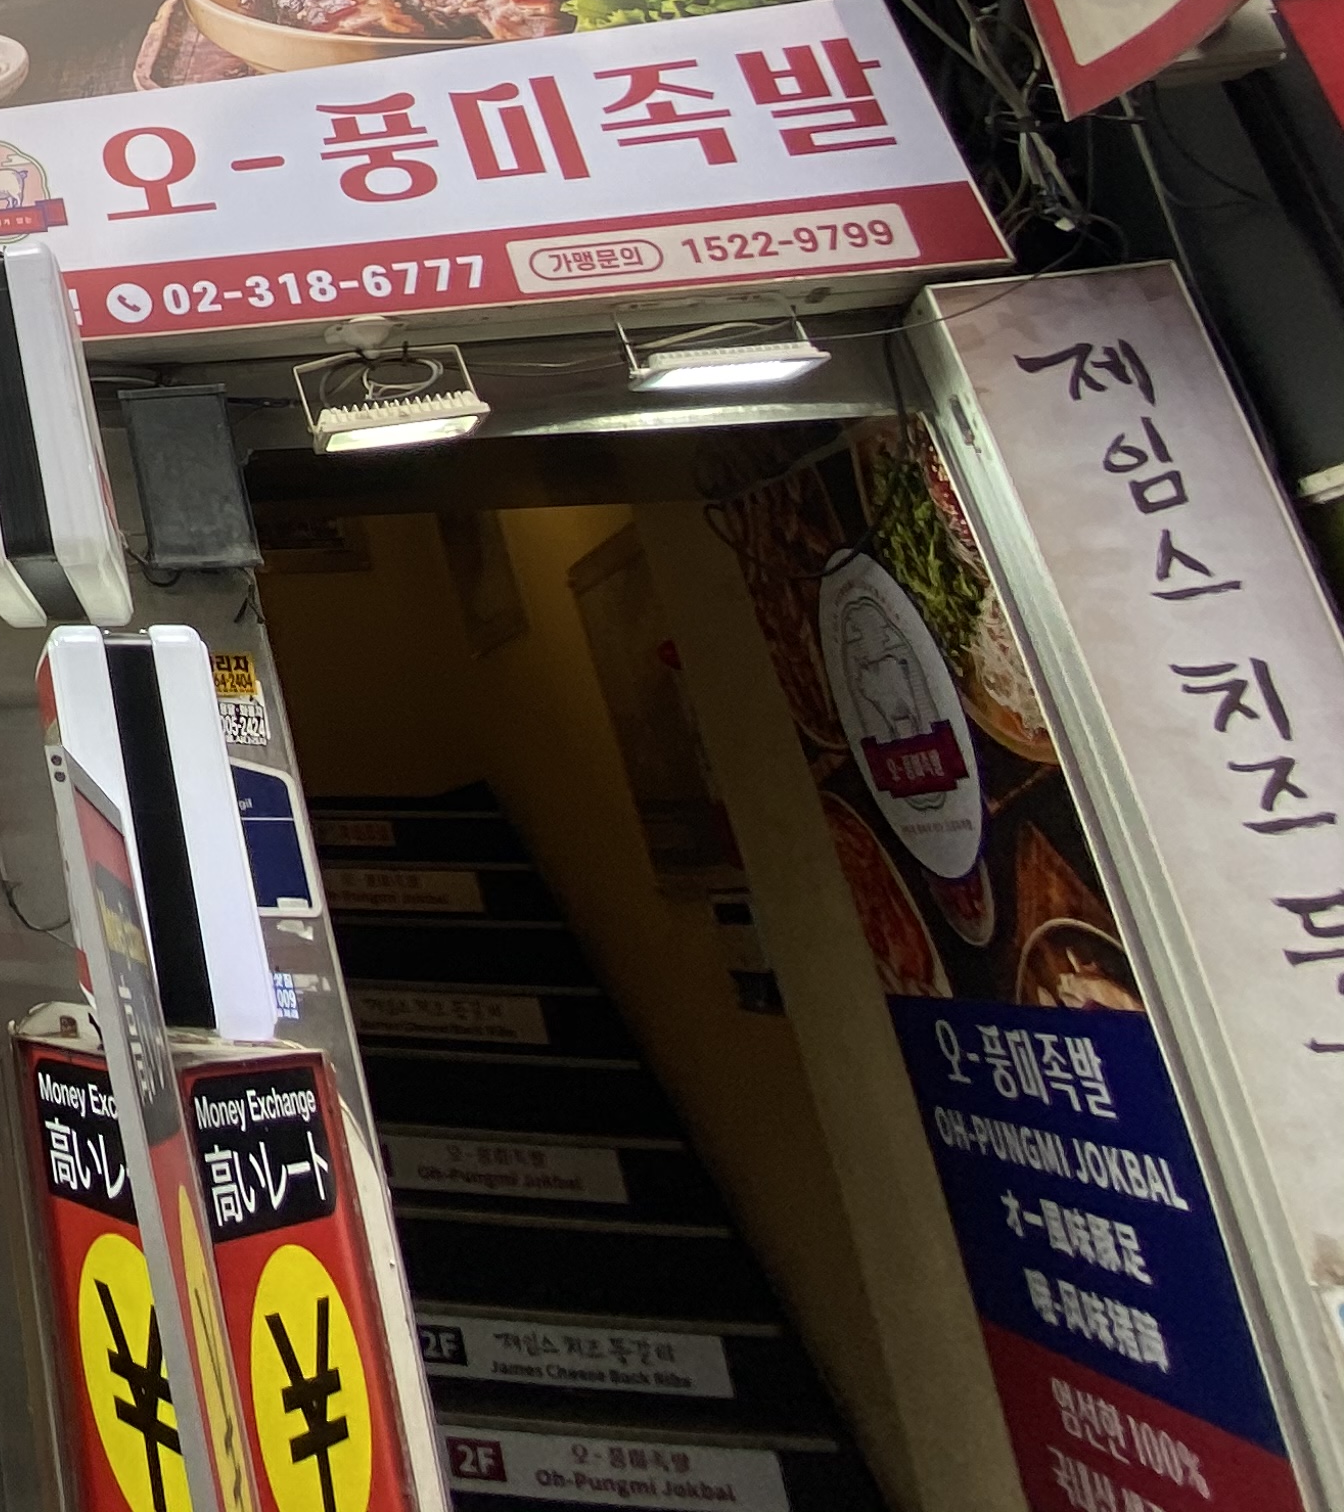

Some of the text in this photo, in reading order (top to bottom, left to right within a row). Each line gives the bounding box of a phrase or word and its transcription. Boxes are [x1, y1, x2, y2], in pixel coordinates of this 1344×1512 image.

[548, 218, 896, 274] 가맹문의 1522-9799
[163, 255, 484, 317] 02-318-6777
[1014, 338, 1338, 834] 제임스 치즈
[211, 655, 249, 673] 리자
[38, 1071, 87, 1118] Money
[194, 1088, 317, 1132] Money Exchange
[45, 1118, 126, 1200] 高いレ
[204, 1131, 330, 1227] 高いレート
[934, 1104, 1193, 1213] OH-PUNGMI JOKBAL
[420, 1329, 460, 1360] 2F
[492, 1331, 677, 1366] 제임스 치즈 등갈비
[490, 1360, 544, 1378] James
[546, 1363, 606, 1383] Cheese
[265, 1296, 350, 1512] ¥
[455, 1443, 496, 1473] 2F
[1126, 1414, 1211, 1501] 100%
[535, 1468, 737, 1503] Oh-Pungmi Jokbal
